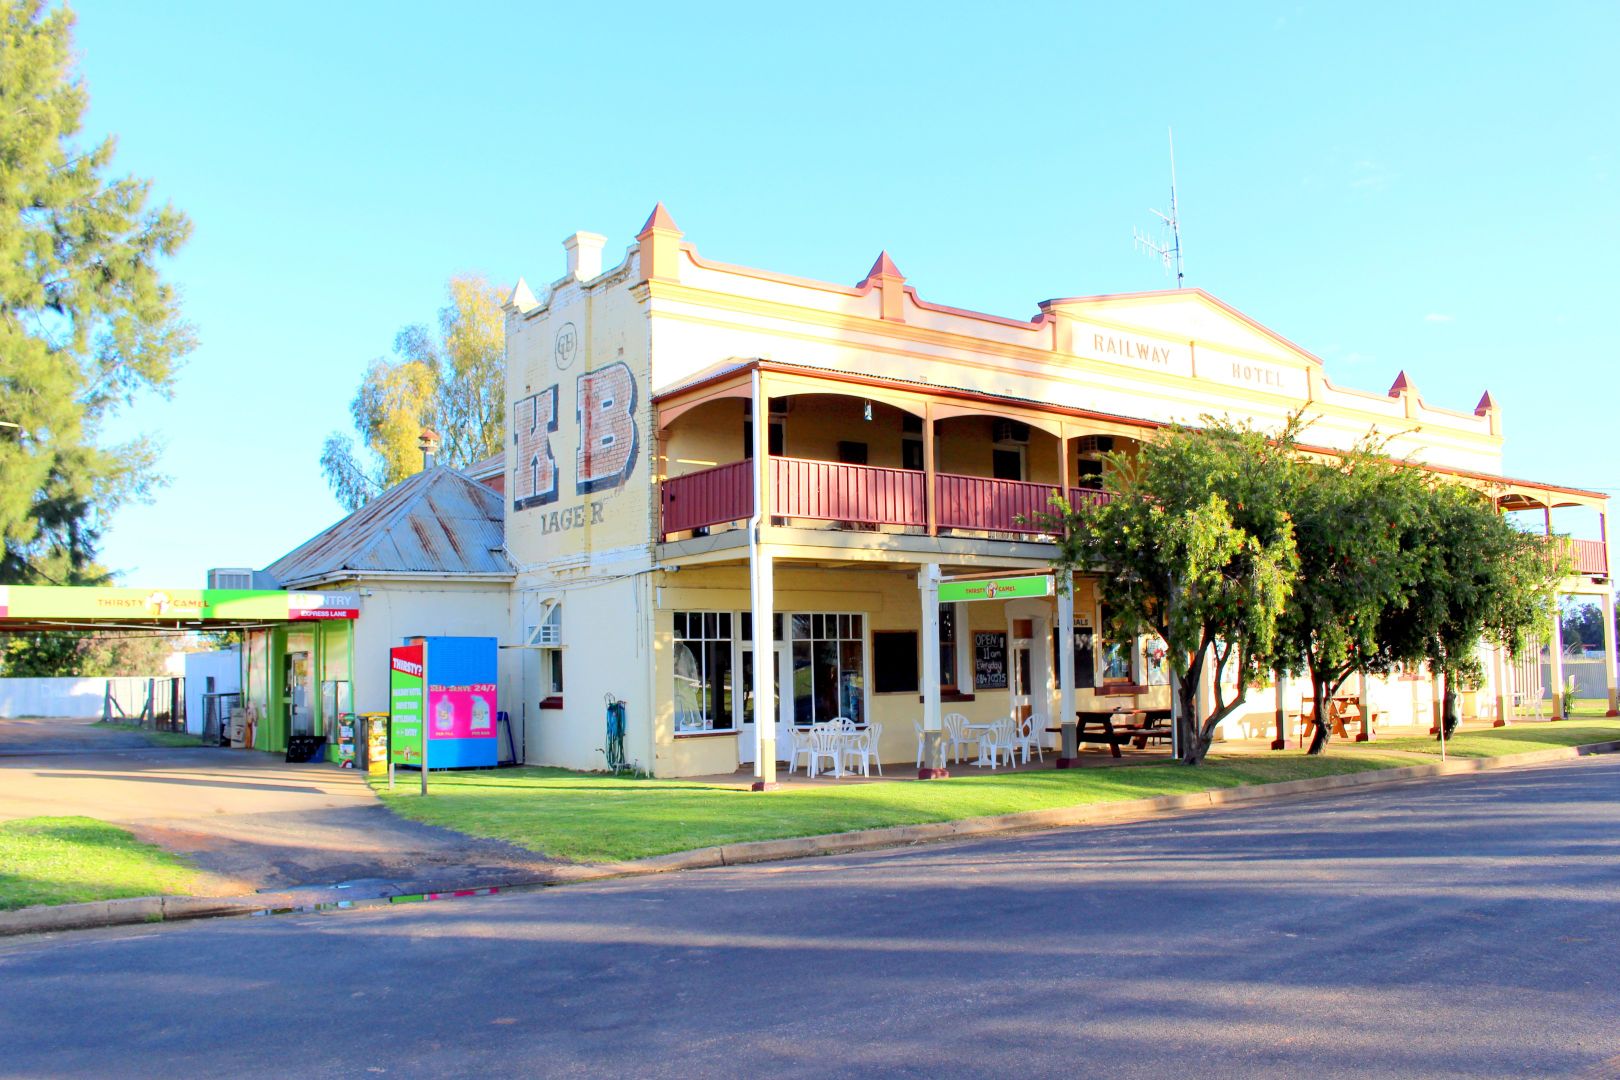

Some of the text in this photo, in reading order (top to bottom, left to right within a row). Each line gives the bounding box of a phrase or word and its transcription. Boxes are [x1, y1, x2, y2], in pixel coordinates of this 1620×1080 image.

[1093, 333, 1283, 388] RAILWAY HOTEL
[541, 502, 604, 536] LAGER
[98, 599, 210, 608] THIRSTY CAMEL
[976, 633, 998, 647] OPEN
[393, 657, 422, 676] THIRSTY?
[474, 684, 497, 692] 24/7
